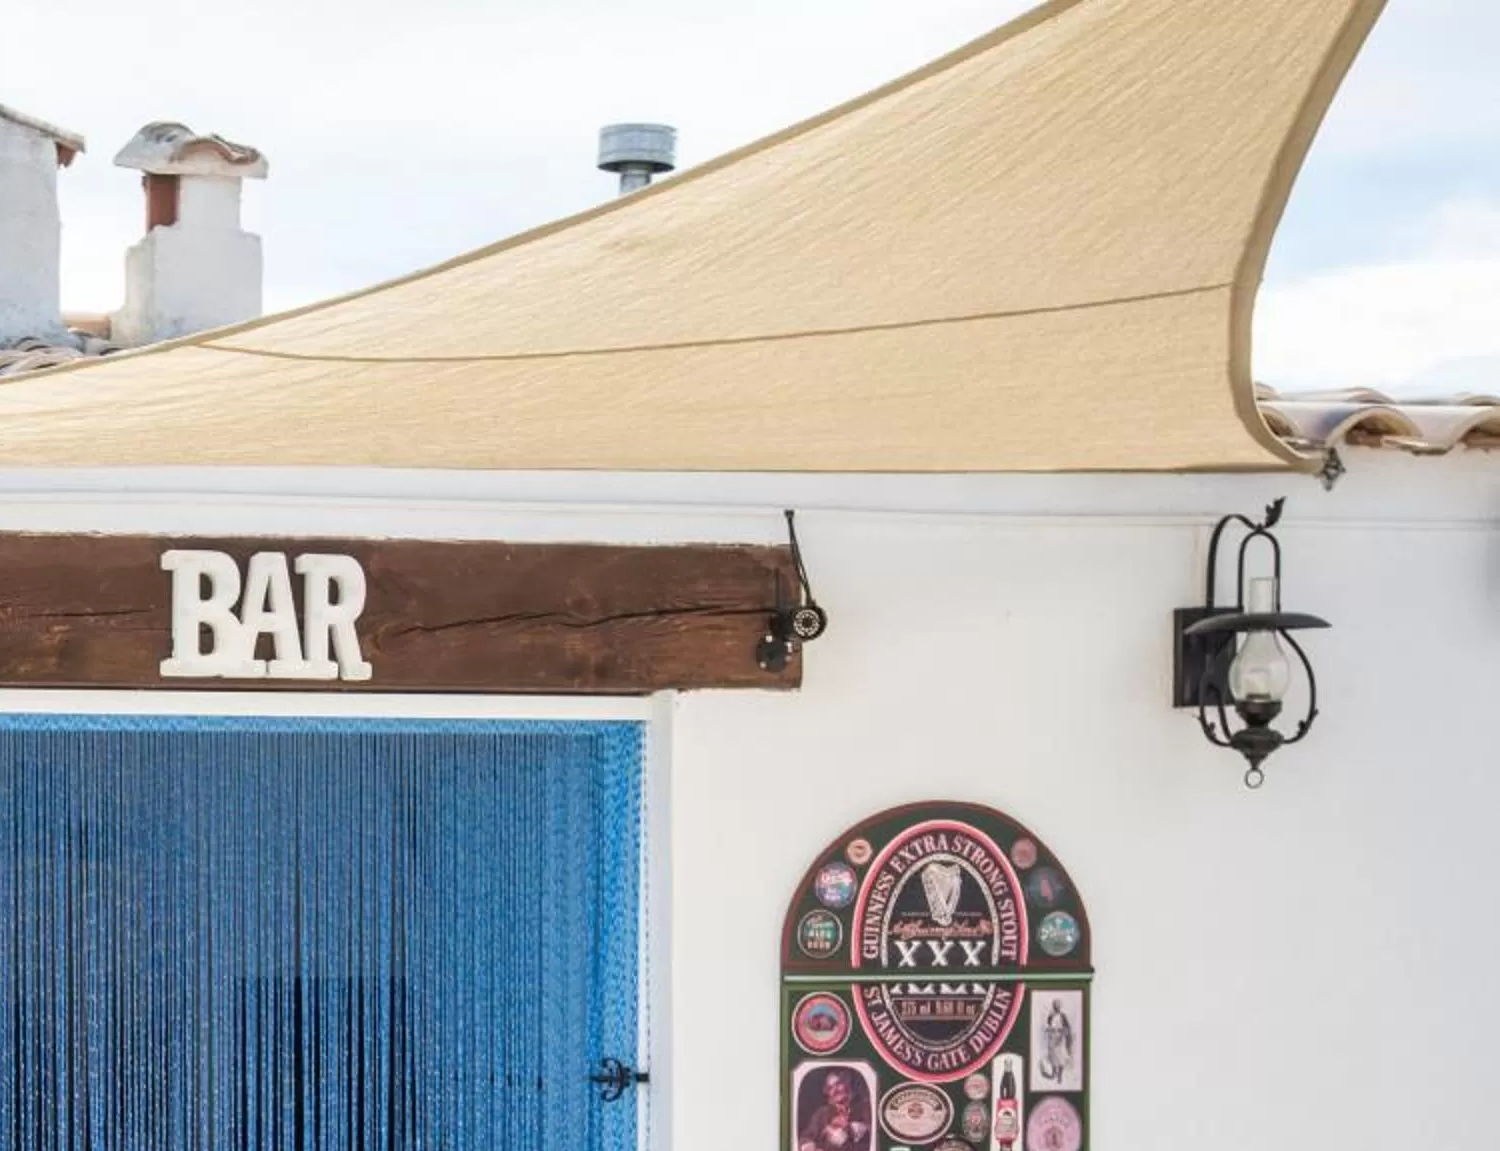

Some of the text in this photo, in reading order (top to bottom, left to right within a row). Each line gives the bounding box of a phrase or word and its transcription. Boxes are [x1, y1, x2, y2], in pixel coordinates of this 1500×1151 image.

[160, 549, 373, 681] BAR
[863, 871, 896, 959] GUINNESS
[889, 833, 949, 874] EXTRA
[951, 834, 1009, 897] STRONG
[997, 898, 1019, 961] STOUT
[927, 1045, 971, 1072] GATE
[968, 987, 1013, 1054] DUBLIN
